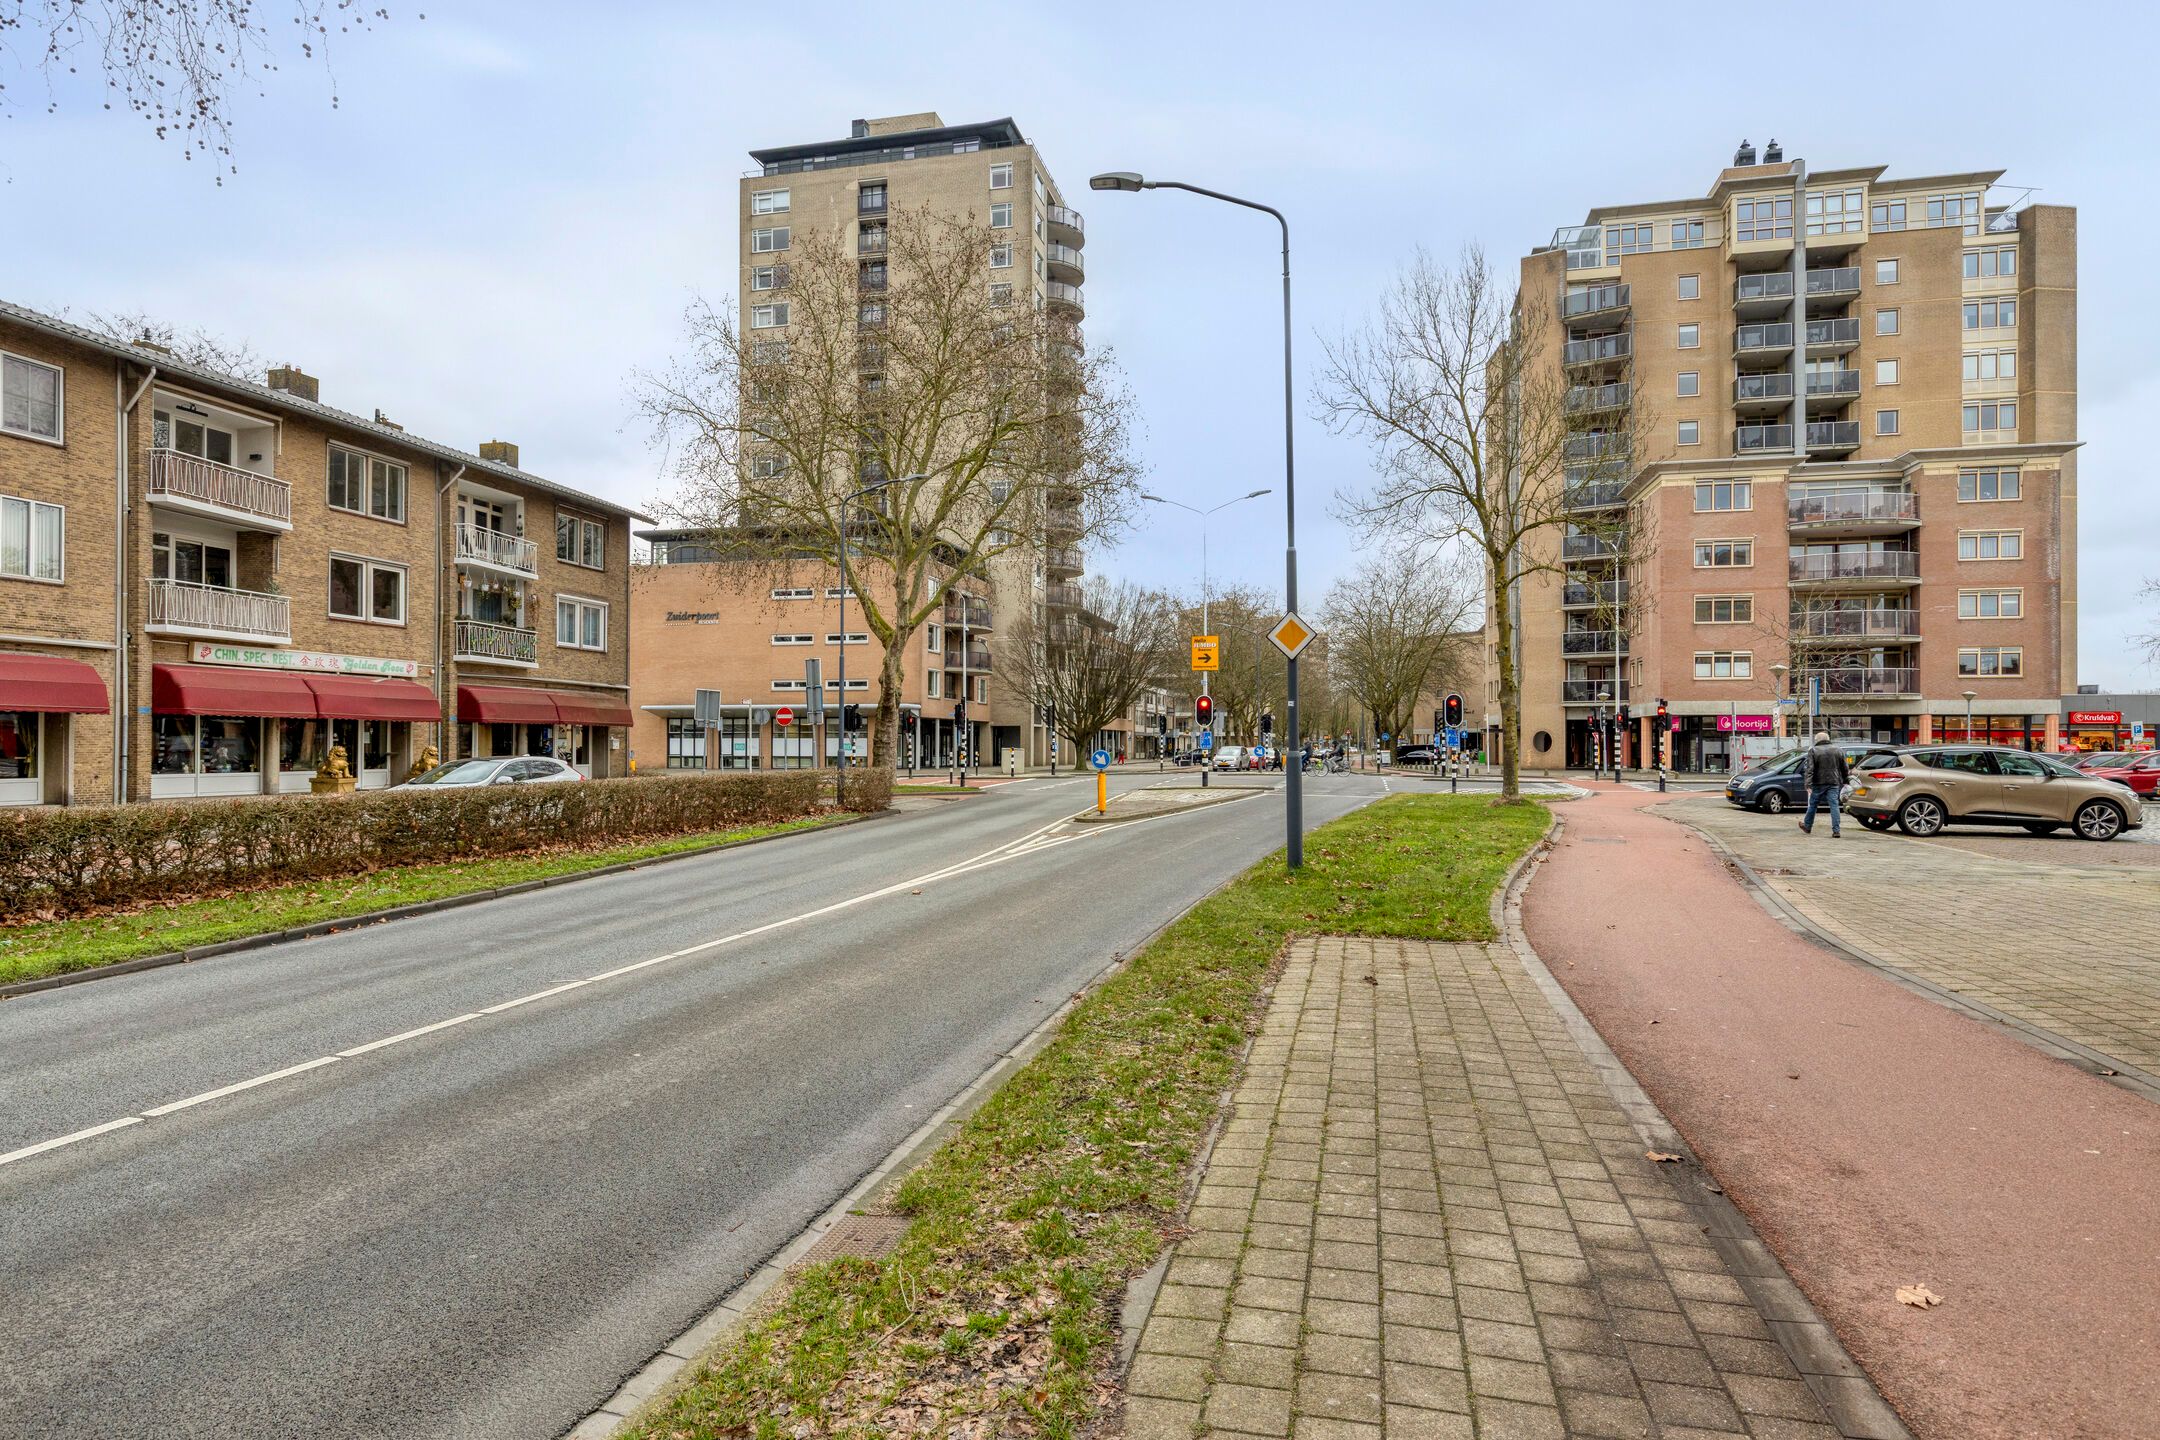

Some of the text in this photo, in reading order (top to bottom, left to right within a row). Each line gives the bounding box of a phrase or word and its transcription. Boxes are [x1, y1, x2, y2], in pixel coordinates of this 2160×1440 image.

[214, 648, 296, 666] CHIN. SPEC. REST.
[343, 657, 405, 673] Golden Rose
[1735, 720, 1769, 730] Hoortijd
